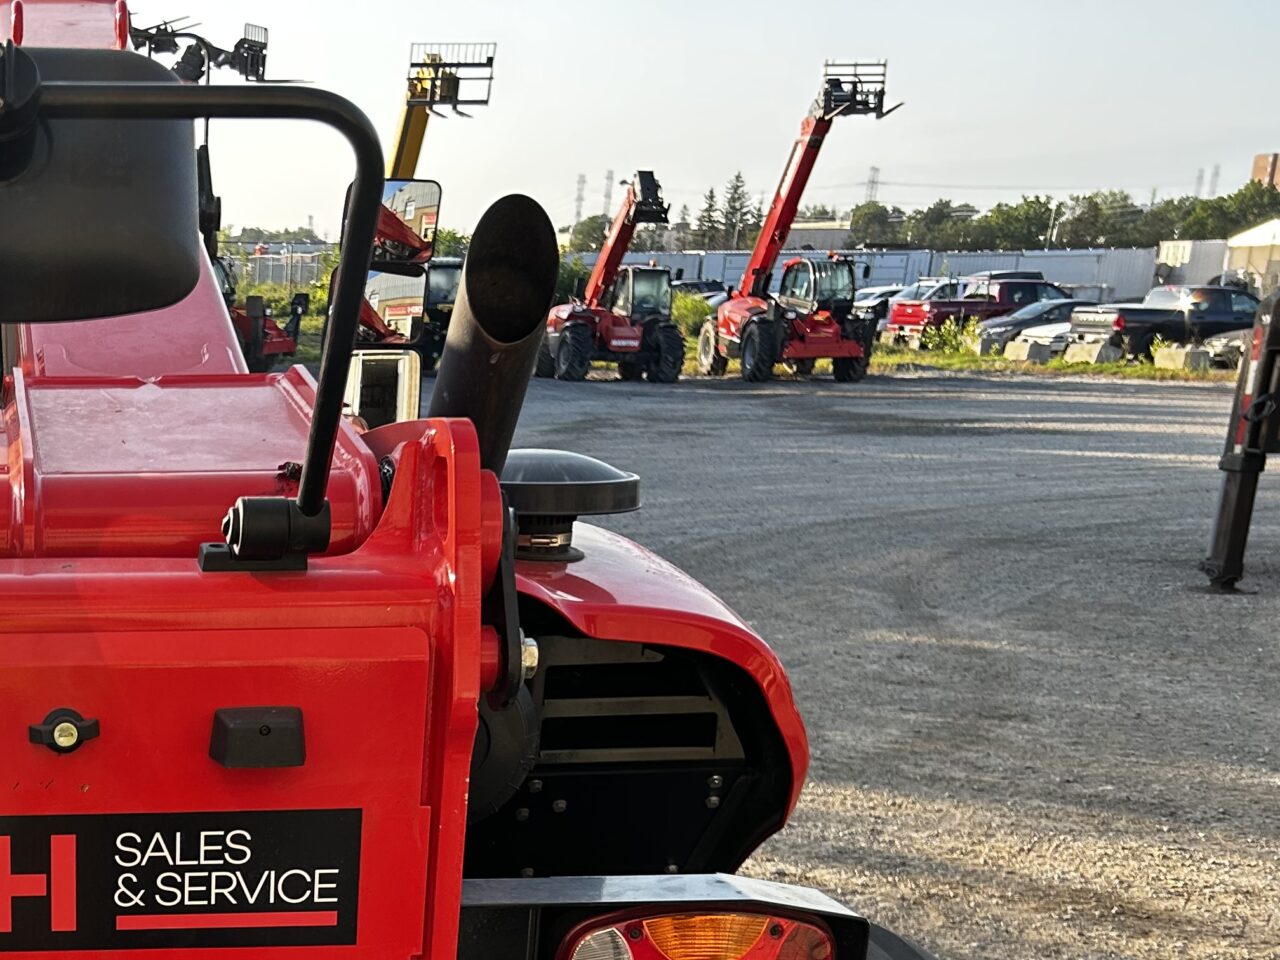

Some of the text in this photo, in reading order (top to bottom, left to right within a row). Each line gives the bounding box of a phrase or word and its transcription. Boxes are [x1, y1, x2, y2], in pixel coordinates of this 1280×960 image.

[114, 829, 252, 868] SALES
[114, 867, 339, 908] & SERVICE
